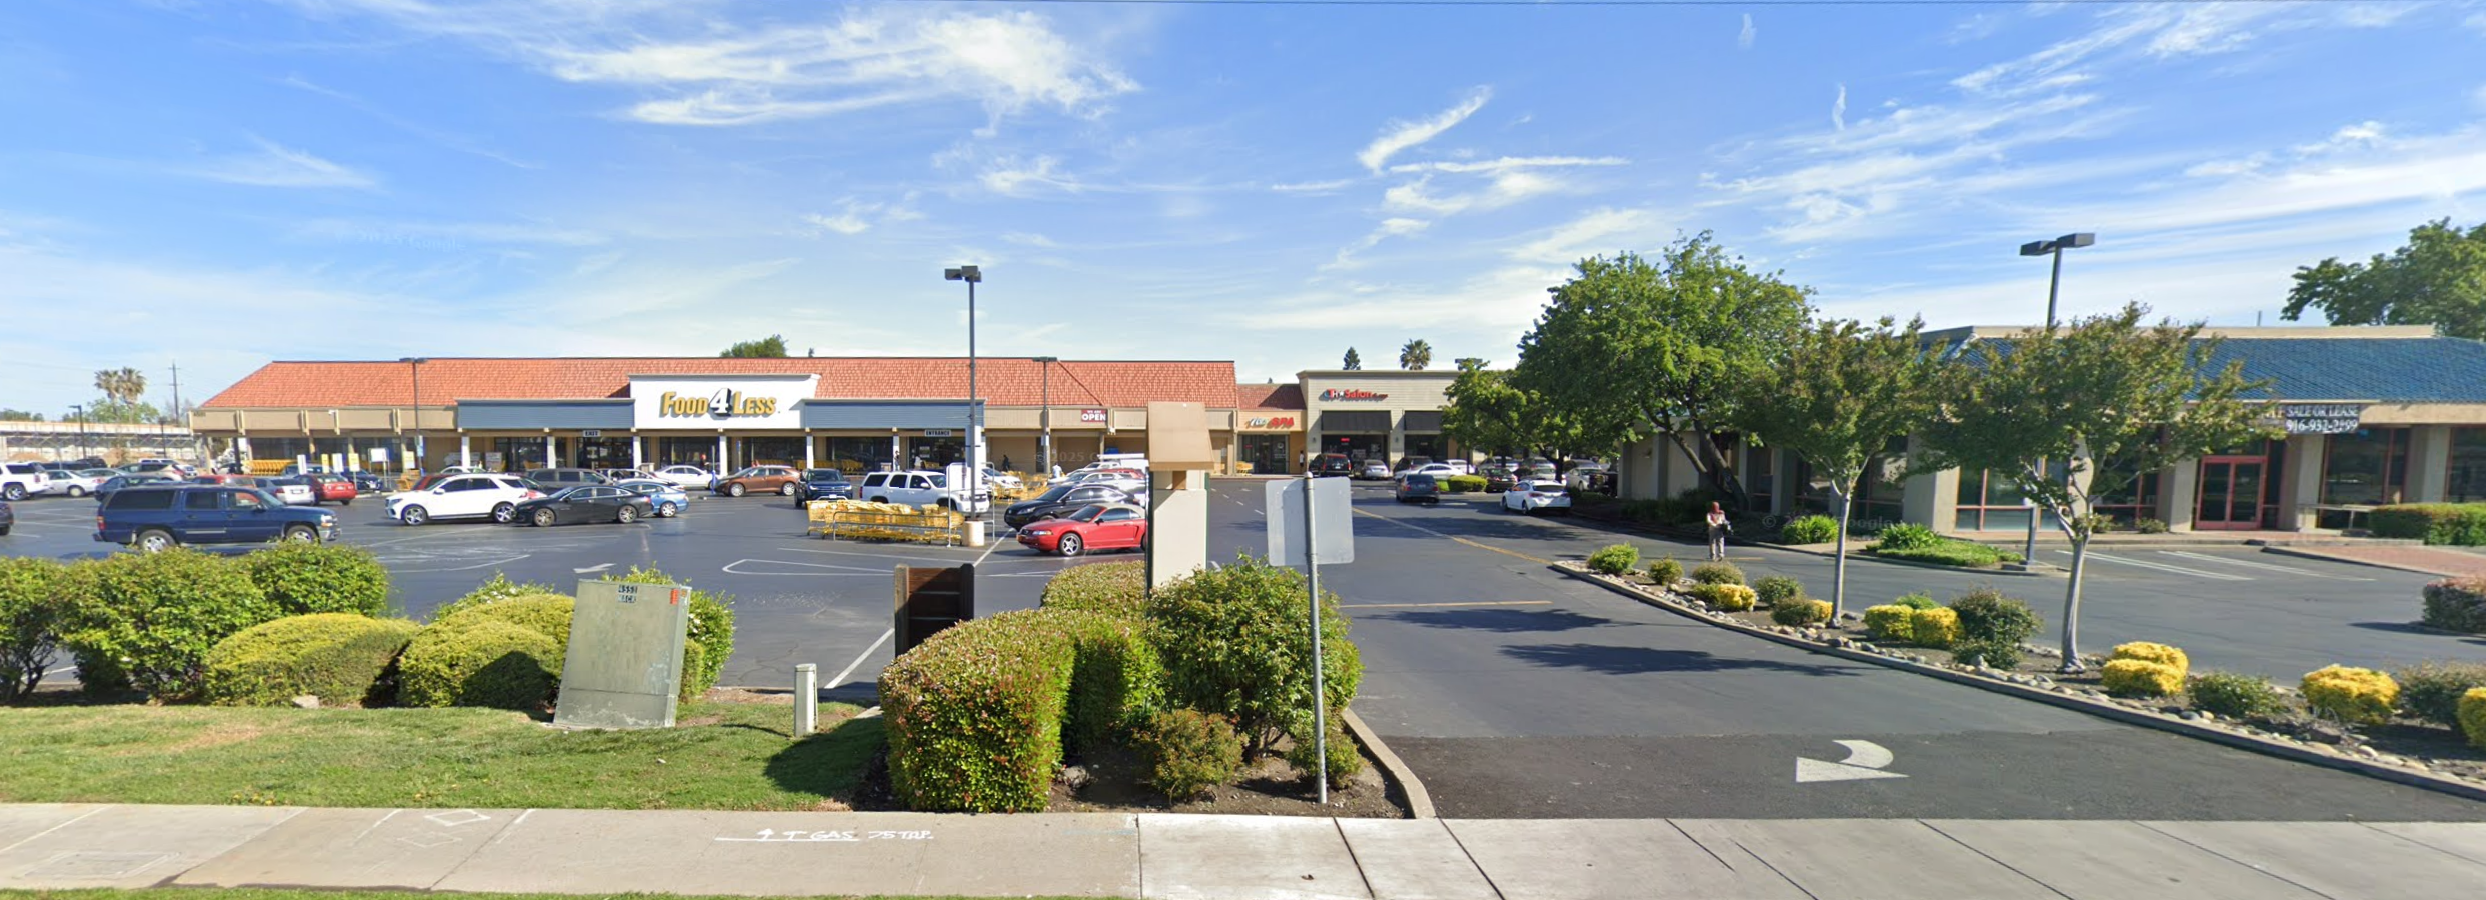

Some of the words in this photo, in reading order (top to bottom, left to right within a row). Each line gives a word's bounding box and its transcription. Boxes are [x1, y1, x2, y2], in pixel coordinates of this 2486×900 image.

[2313, 405, 2328, 417] OR
[2330, 405, 2359, 417] LEASE
[1081, 413, 1106, 421] OPEN
[1271, 417, 1294, 427] SPA
[810, 830, 855, 840] GAS
